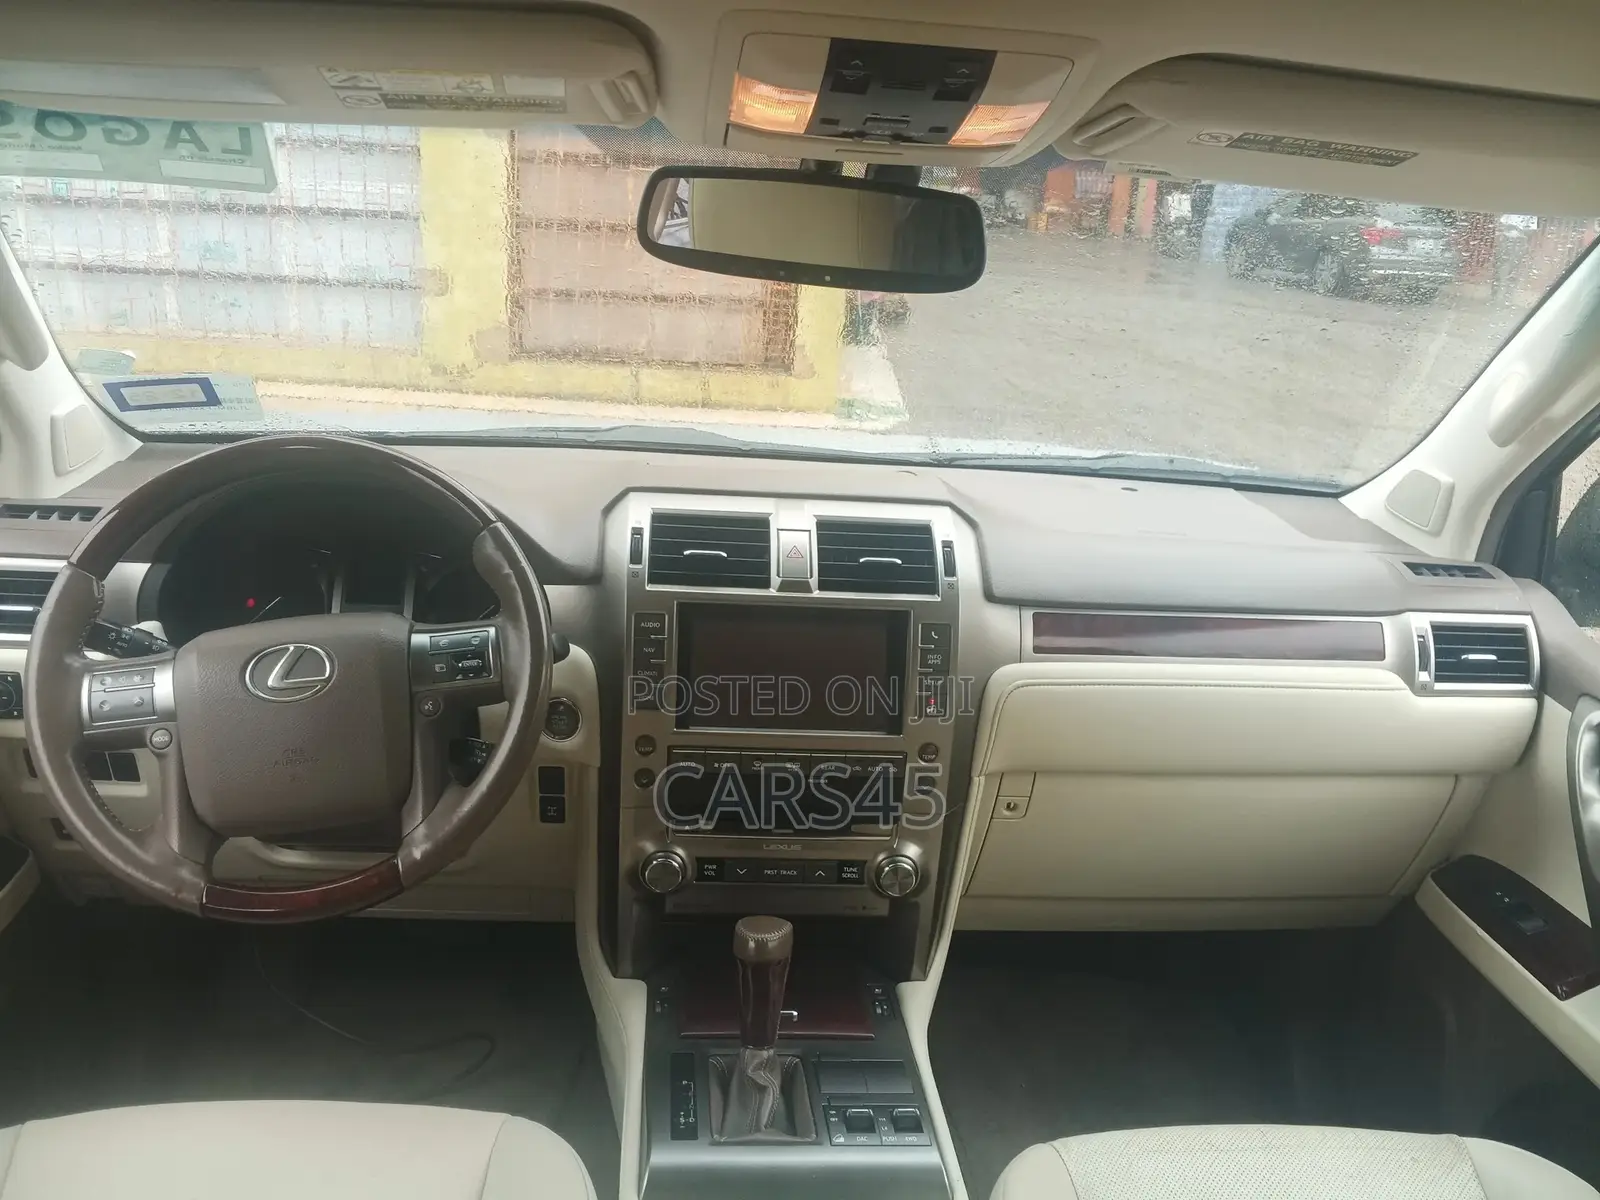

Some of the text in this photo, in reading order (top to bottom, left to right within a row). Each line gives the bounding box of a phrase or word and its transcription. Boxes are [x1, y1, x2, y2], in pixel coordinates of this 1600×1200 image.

[1242, 133, 1415, 157] AIR BAG WARNING
[640, 621, 661, 629] AUDIO
